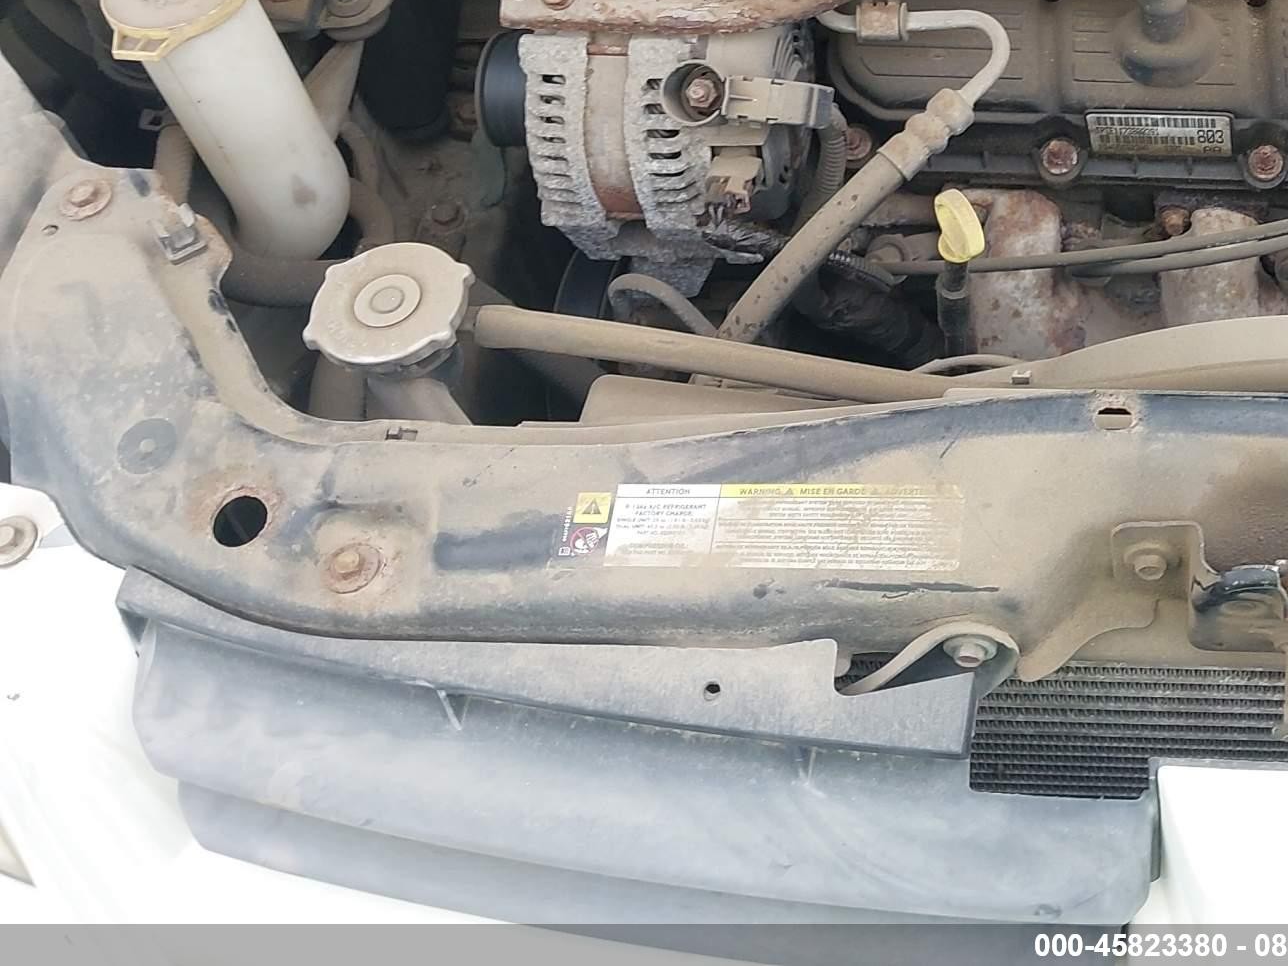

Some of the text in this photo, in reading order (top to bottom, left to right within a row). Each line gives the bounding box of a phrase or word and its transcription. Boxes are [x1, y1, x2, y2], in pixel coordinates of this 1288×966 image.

[1196, 129, 1225, 144] 803
[739, 487, 781, 495] WARNING
[799, 487, 821, 495] MISE
[836, 487, 865, 495] GARDE
